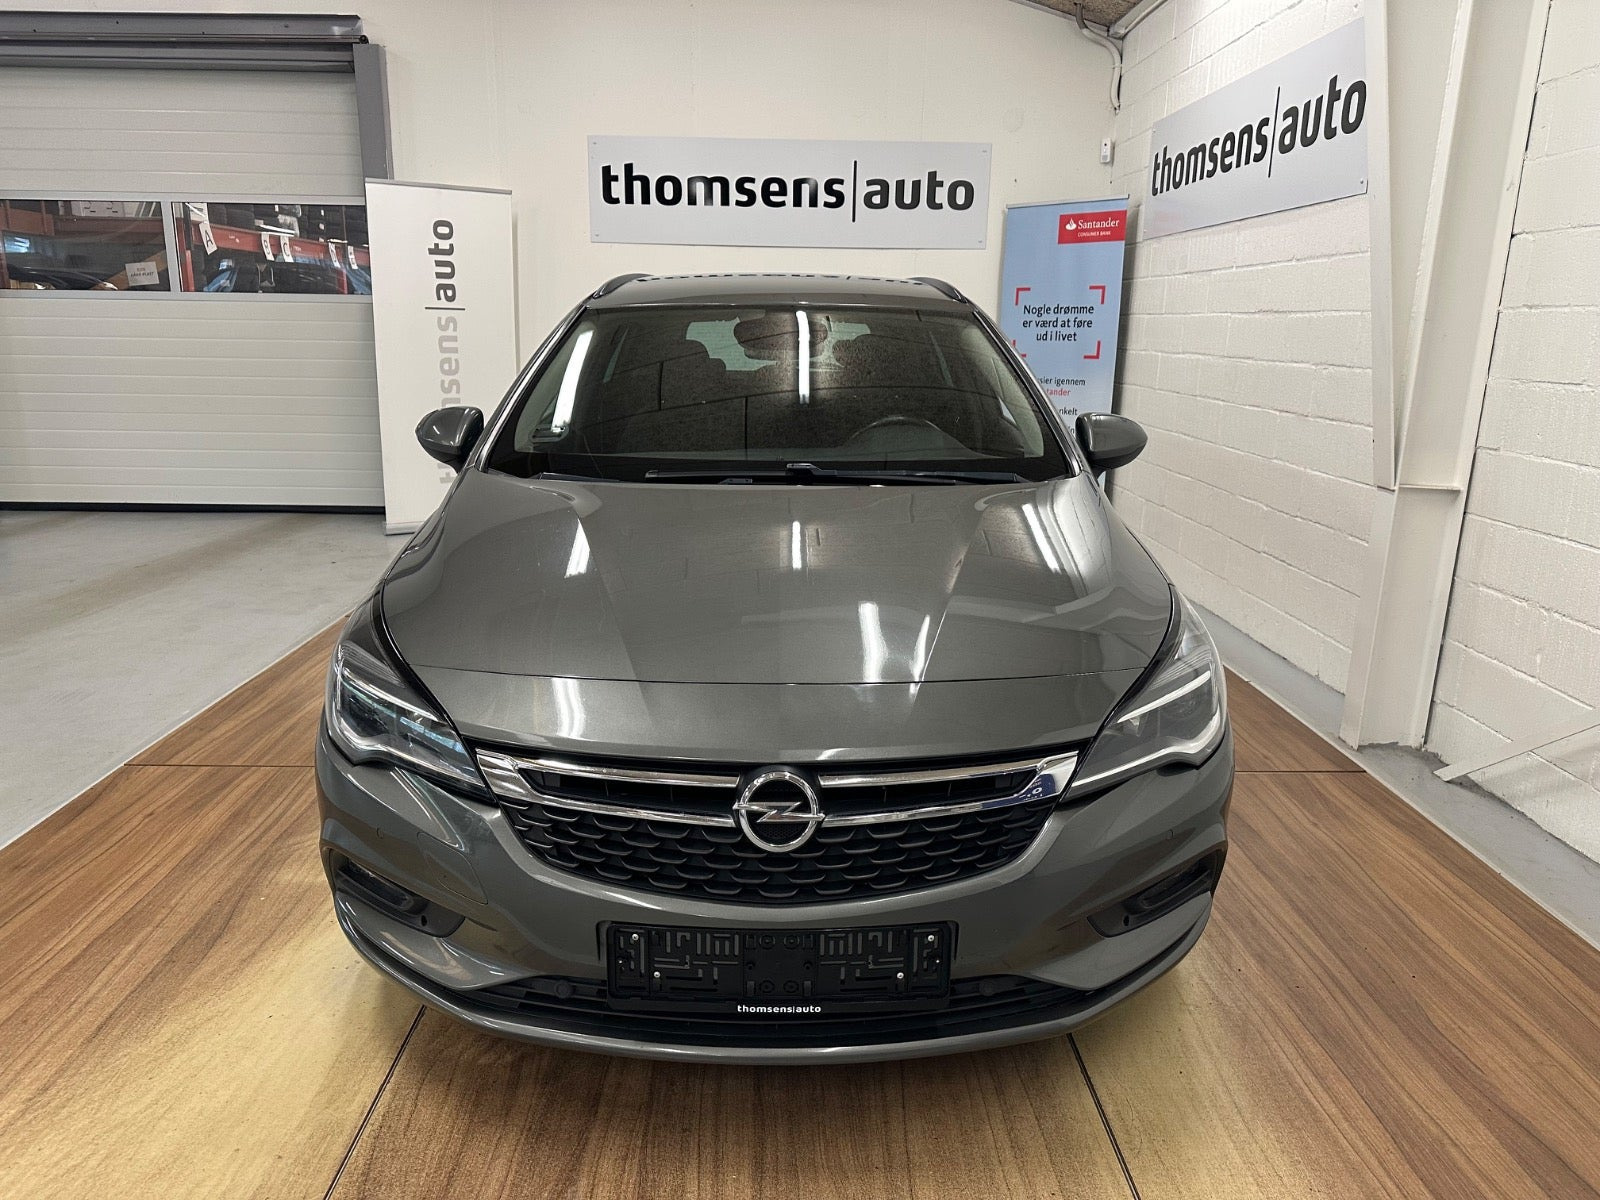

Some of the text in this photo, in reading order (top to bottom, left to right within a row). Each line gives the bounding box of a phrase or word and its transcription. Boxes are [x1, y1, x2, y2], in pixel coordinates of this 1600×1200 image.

[1077, 217, 1120, 229] Santander
[1023, 304, 1094, 317] Nogle drømme
[1022, 317, 1093, 328] er værd at føre
[1036, 331, 1077, 341] ud i livet
[1054, 376, 1086, 387] igennem
[1046, 388, 1071, 396] tander
[1059, 407, 1078, 415] nkelt
